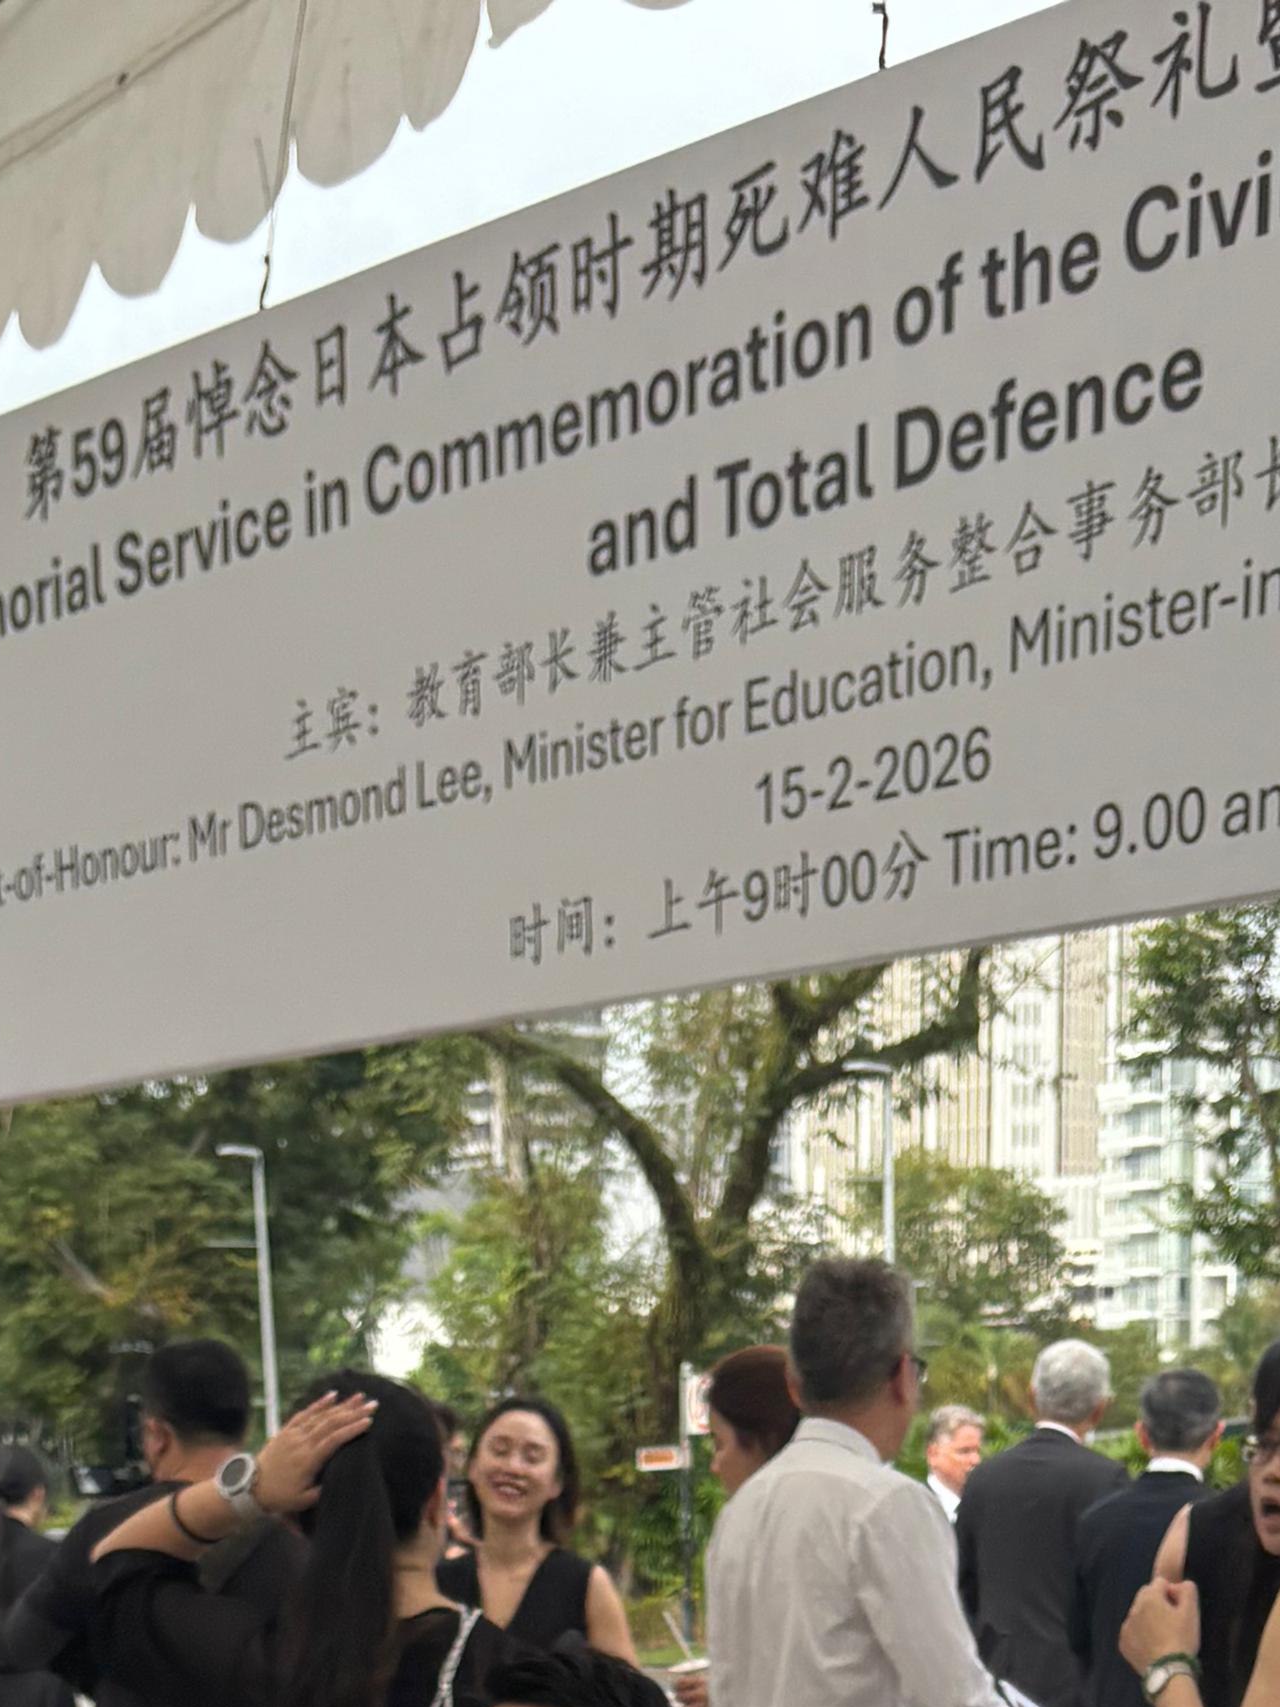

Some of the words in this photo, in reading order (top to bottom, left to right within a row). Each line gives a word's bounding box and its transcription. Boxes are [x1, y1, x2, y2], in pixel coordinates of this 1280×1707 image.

[115, 498, 291, 596] Service
[305, 472, 350, 538] in
[364, 303, 872, 515] Commemoration
[894, 250, 963, 347] of
[979, 230, 1101, 319] the
[588, 475, 698, 577] and
[714, 422, 874, 538] Total
[894, 348, 1203, 490] Defence
[189, 813, 231, 861] Mr
[239, 765, 406, 850] Desmond
[416, 760, 492, 809] Lee,
[504, 716, 665, 789] Minister
[674, 698, 728, 749] for
[745, 640, 992, 734] Education,
[756, 726, 991, 824] 15-2-2026
[943, 824, 1077, 886] Time:
[1094, 786, 1206, 860] 9.00
